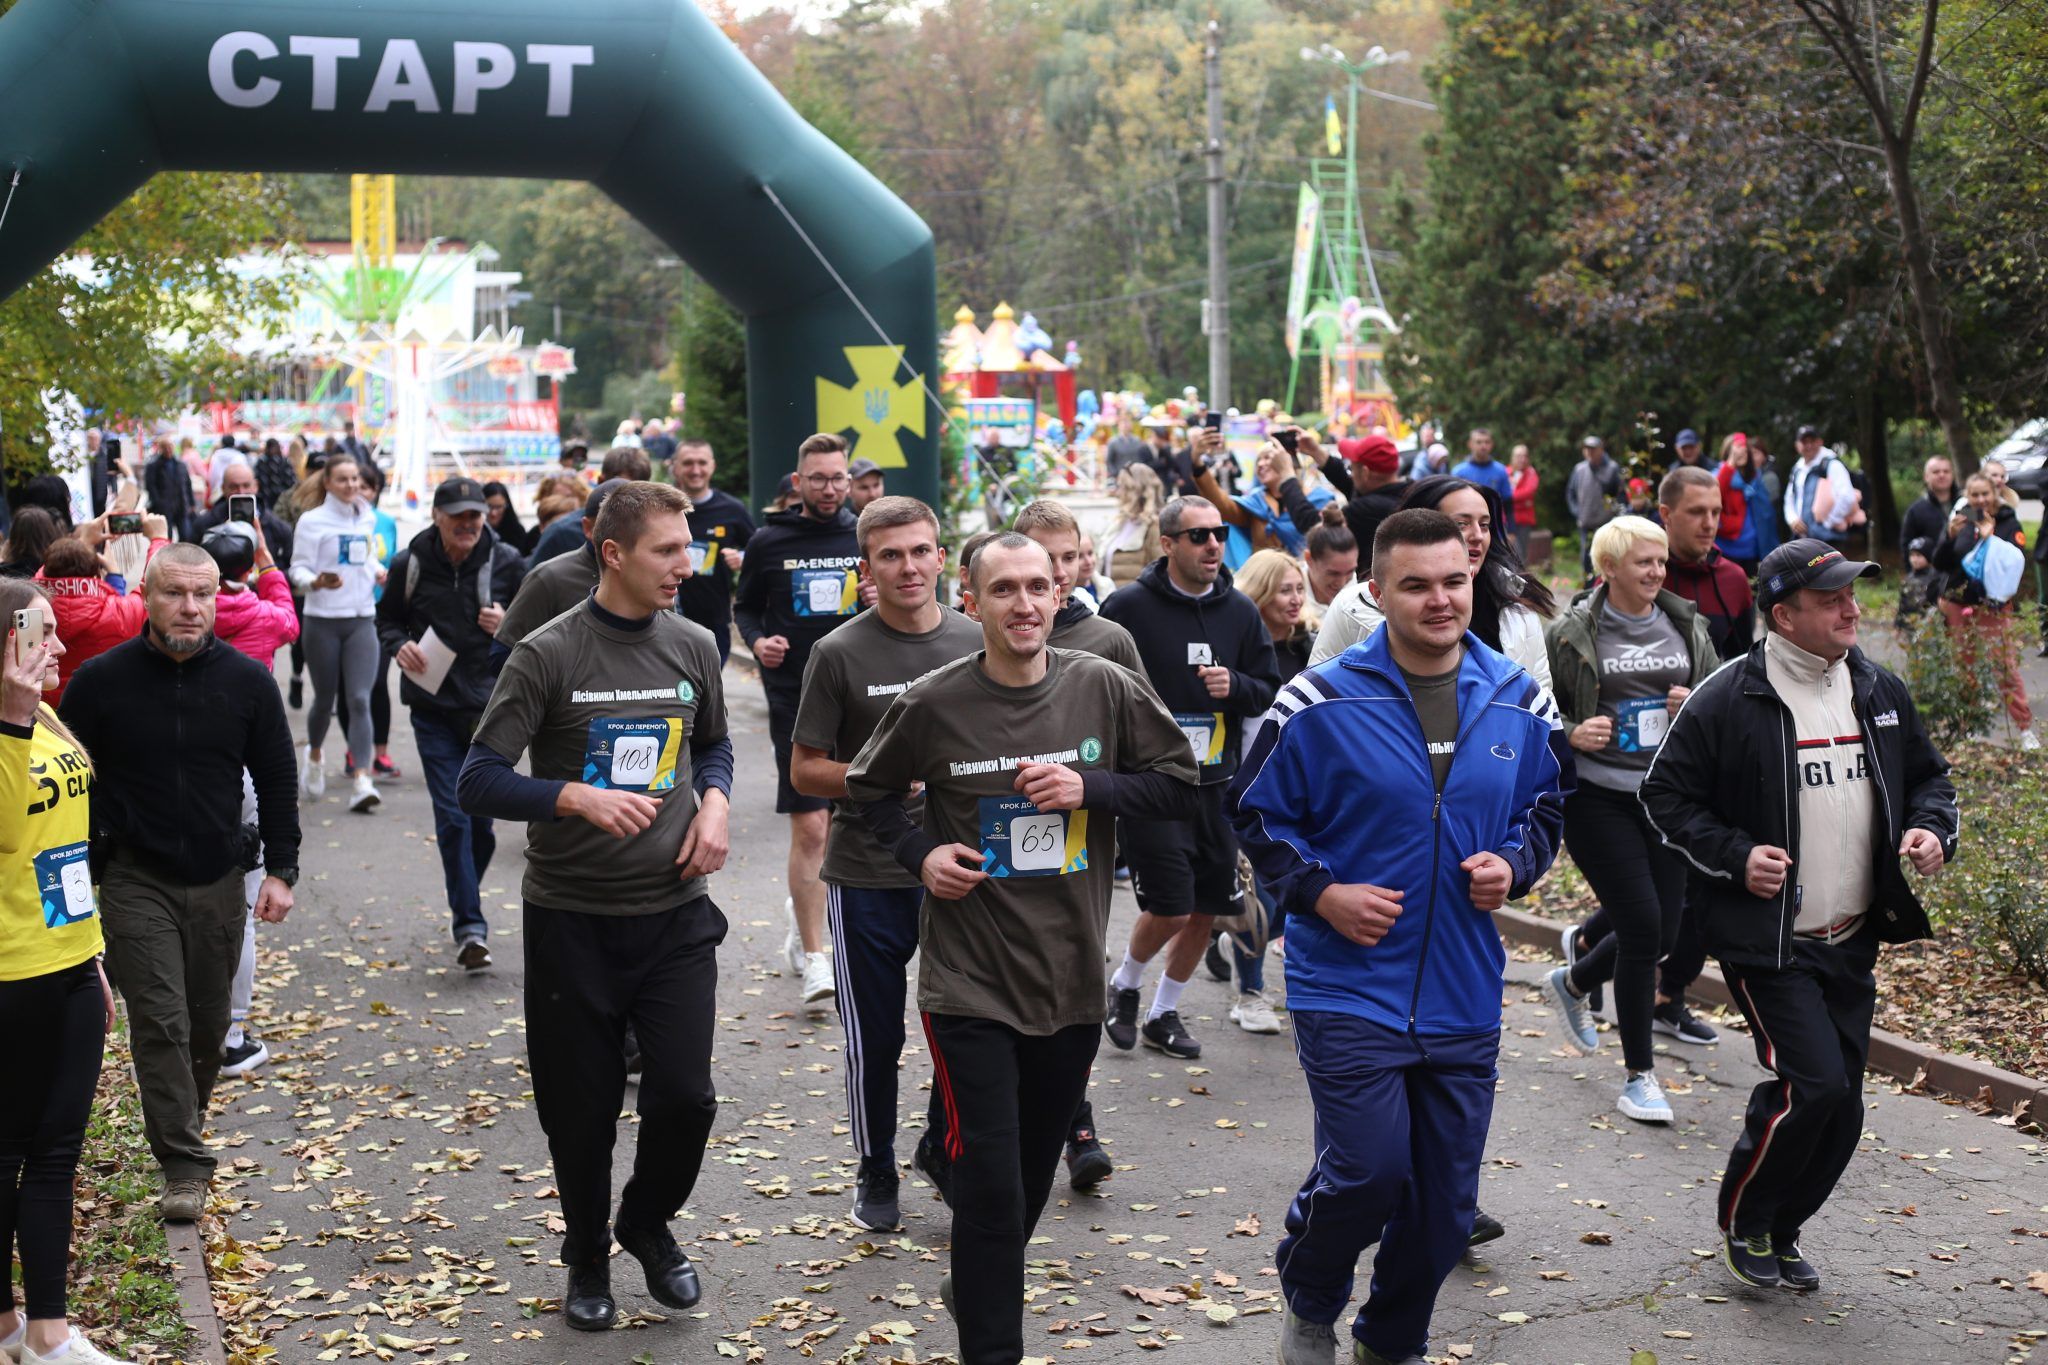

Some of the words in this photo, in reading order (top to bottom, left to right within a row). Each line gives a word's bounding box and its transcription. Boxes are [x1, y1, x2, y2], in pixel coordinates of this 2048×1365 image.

[208, 31, 594, 117] СТАРТ
[40, 578, 99, 598] ASHION
[1603, 652, 1689, 675] Reebok
[571, 690, 614, 703] Лісівники
[625, 723, 635, 731] ДО
[618, 746, 652, 772] 108
[1020, 801, 1033, 809] ДО
[1021, 823, 1061, 853] 65
